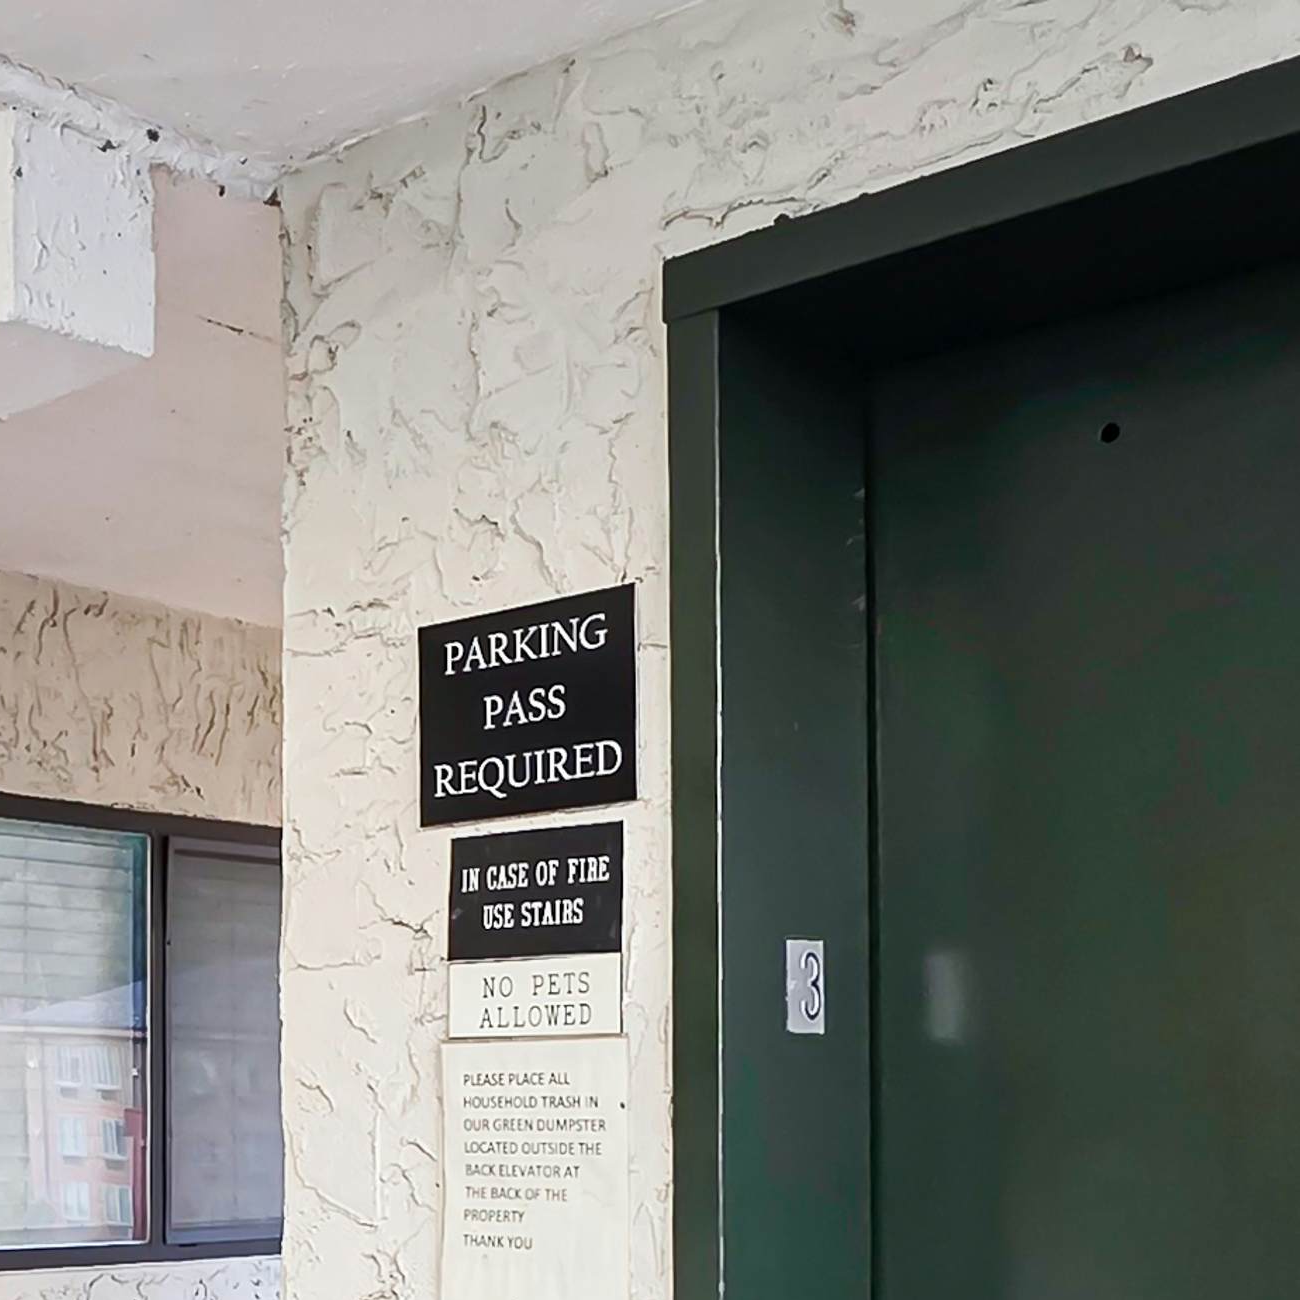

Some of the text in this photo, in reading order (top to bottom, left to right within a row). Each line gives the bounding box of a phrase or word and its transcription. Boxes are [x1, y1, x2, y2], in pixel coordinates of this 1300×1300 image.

[444, 613, 608, 676] PARKING
[483, 684, 567, 730] PASS
[433, 739, 623, 798] REQUIRED
[461, 855, 610, 893] IN CASE OF FIRE
[483, 898, 584, 930] USE STAIRS
[483, 972, 591, 999] NO PETS
[800, 949, 821, 1023] 3
[479, 1003, 592, 1029] ALLOWED
[463, 1072, 570, 1087] PLEASE PLACE ALL
[463, 1096, 599, 1109] HOUSEHOLD TRASH IN
[463, 1118, 606, 1132] OUR GREEN DUMPSTER
[464, 1141, 602, 1156] LOCATED OUTSIDE THE
[465, 1164, 581, 1179] BACK ELEVATOR AT
[465, 1186, 568, 1202] THE BACK OF THE
[463, 1208, 525, 1223] PROPERTY
[463, 1234, 533, 1250] THANK YOU
